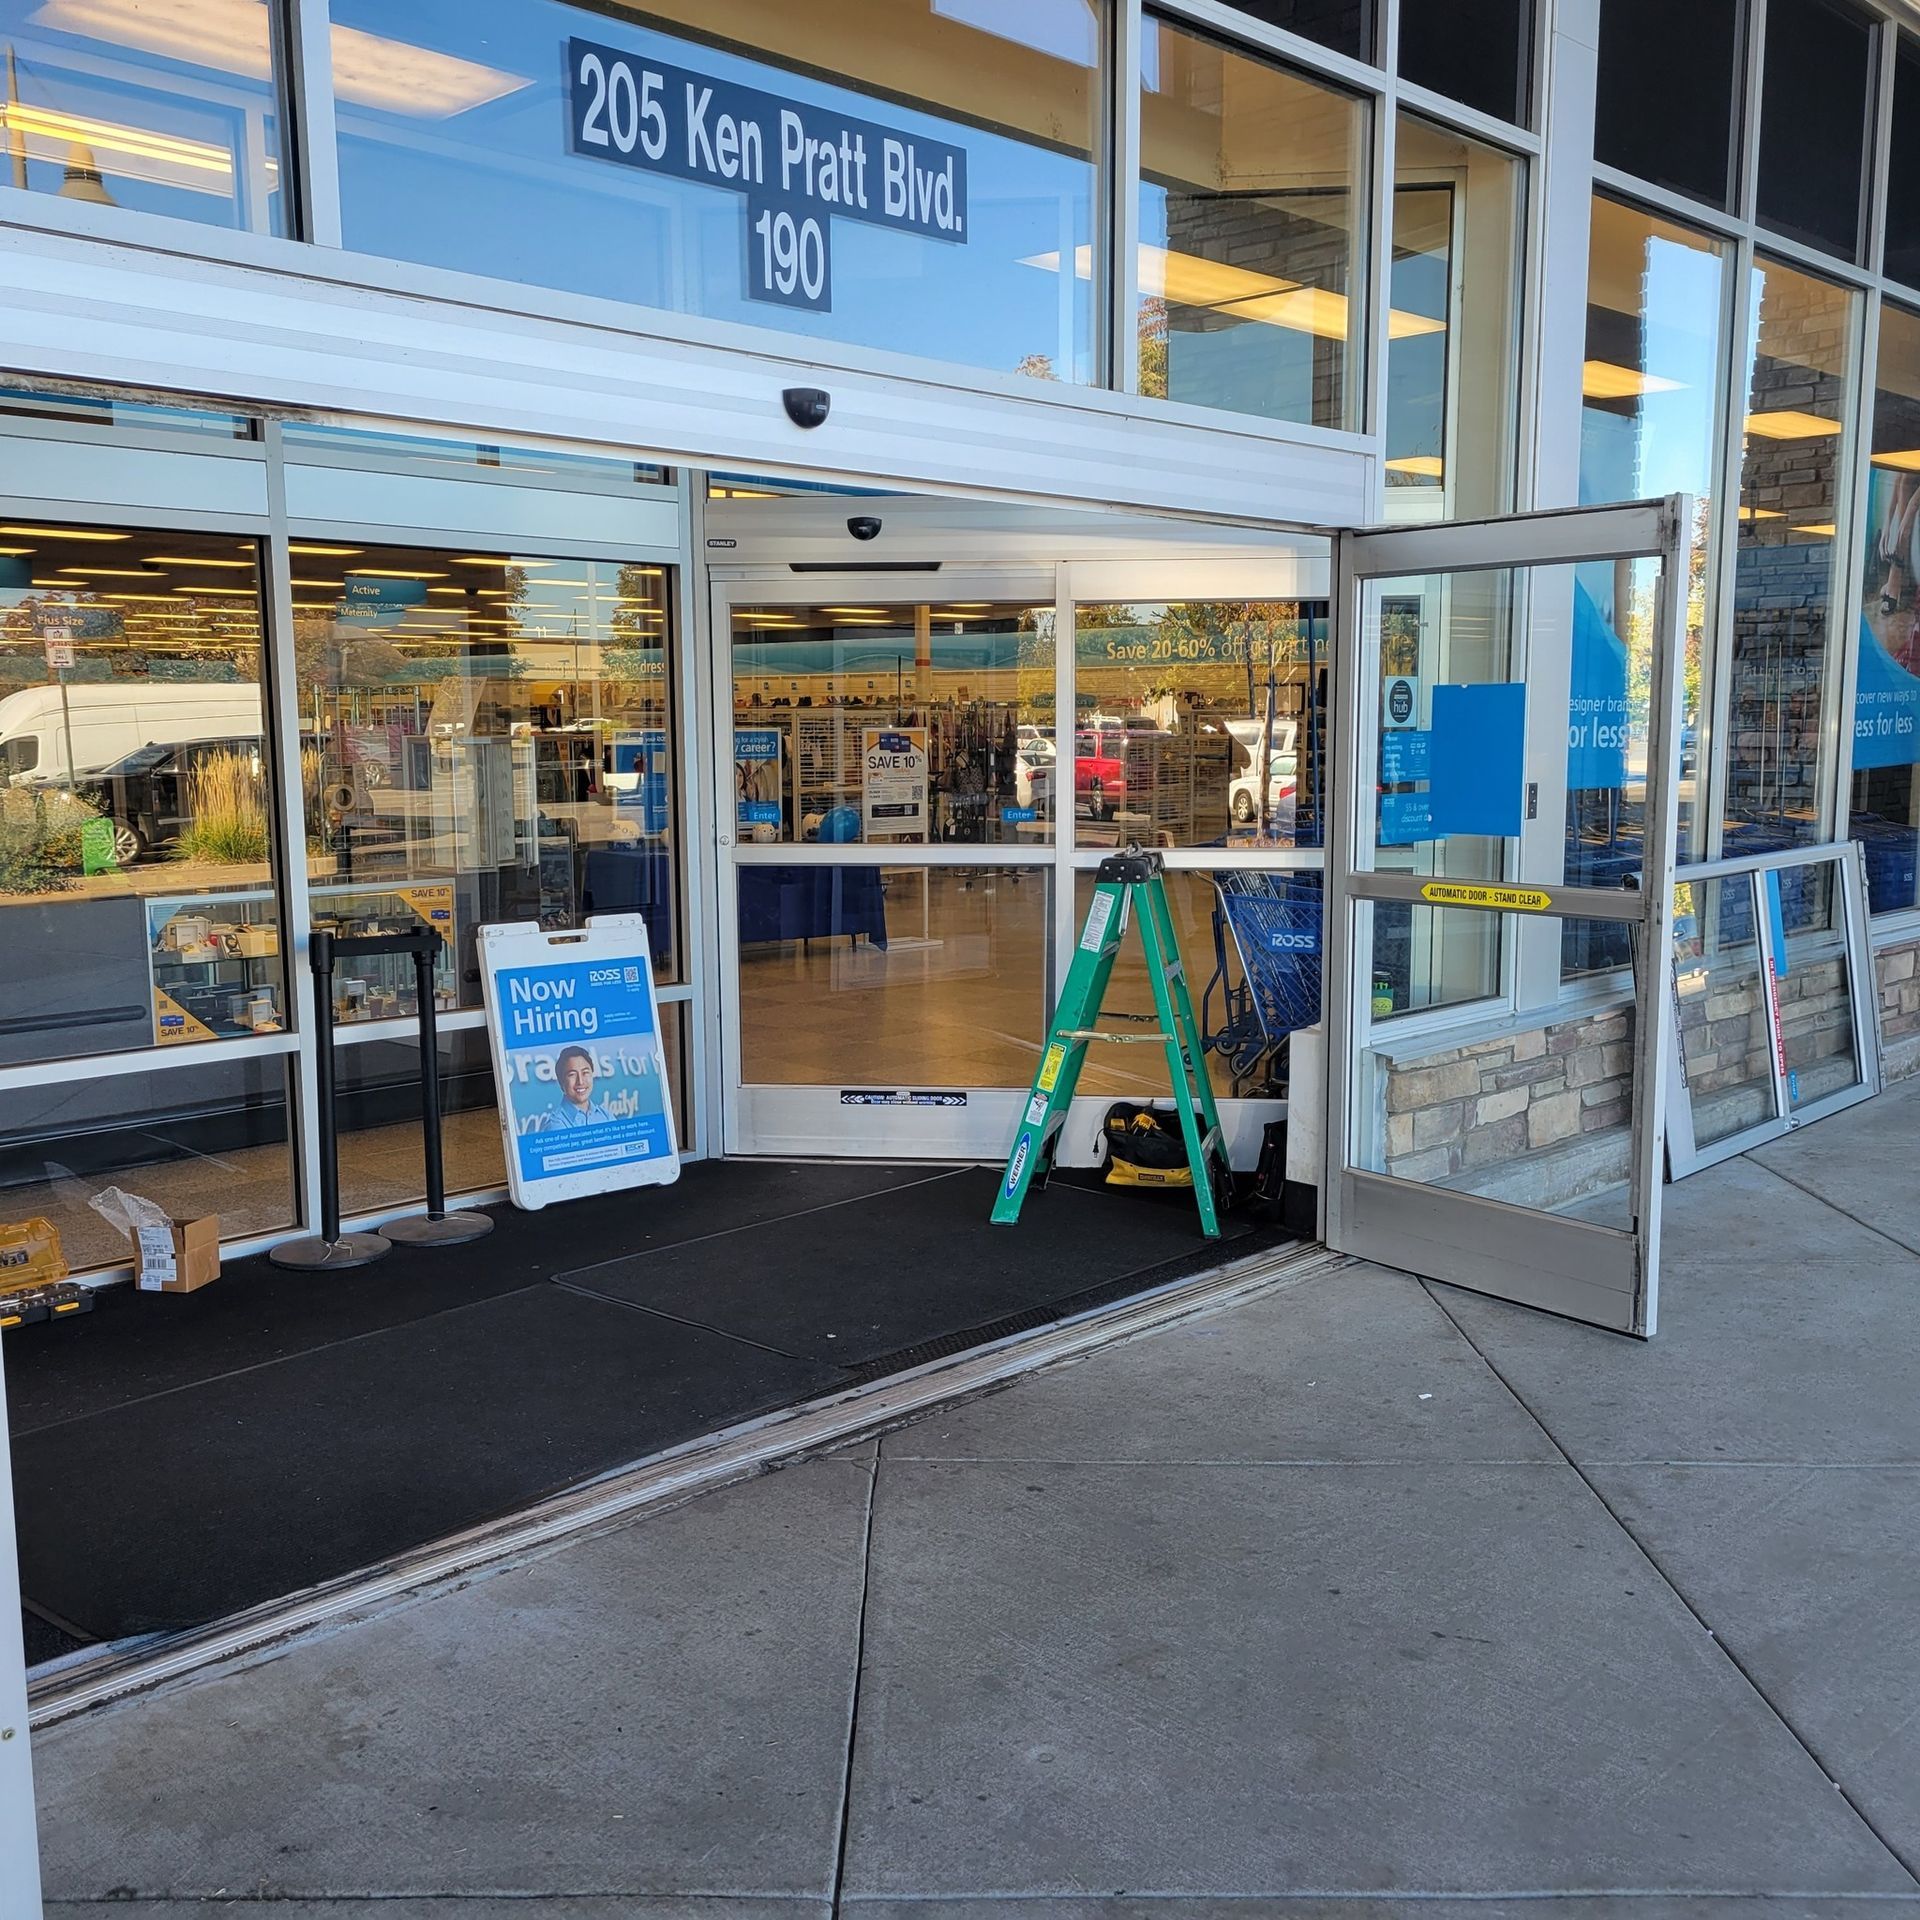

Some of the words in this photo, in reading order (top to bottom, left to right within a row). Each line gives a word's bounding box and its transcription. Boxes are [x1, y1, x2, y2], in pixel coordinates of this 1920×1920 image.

[580, 53, 668, 160] 205
[686, 82, 764, 184] Ken
[781, 109, 868, 209] Pratt
[883, 137, 962, 233] Blvd.
[755, 209, 825, 300] 190
[352, 585, 380, 596] Active
[340, 607, 378, 619] Maternity
[62, 616, 85, 626] Size
[1106, 641, 1147, 660] Save
[1151, 638, 1215, 659] 20-60%
[1221, 636, 1247, 656] off
[1876, 691, 1892, 703] new
[1893, 691, 1910, 706] ways
[1394, 701, 1408, 713] hub
[1592, 716, 1625, 748] less
[1852, 720, 1874, 738] ess
[1876, 711, 1892, 735] for
[1895, 711, 1913, 734] less
[741, 741, 776, 753] career?
[868, 756, 900, 769] SAVE
[903, 755, 922, 769] 10%
[754, 812, 776, 820] Enter
[1007, 810, 1031, 819] Enter
[411, 889, 434, 897] SAVE
[1429, 887, 1467, 900] AUTOMATIC
[1468, 890, 1487, 901] DOOR
[1494, 892, 1517, 904] STAND
[1519, 894, 1542, 906] CLEAR
[1271, 933, 1315, 949] ROSS
[589, 969, 621, 982] ROSS
[509, 977, 576, 1004] Now
[1771, 970, 1779, 1016] EMERGENCY
[1778, 1041, 1784, 1052] TO
[513, 1004, 598, 1035] Hiring
[161, 1027, 184, 1037] SAVE
[618, 1048, 648, 1077] for
[1009, 1145, 1027, 1185] WERNER
